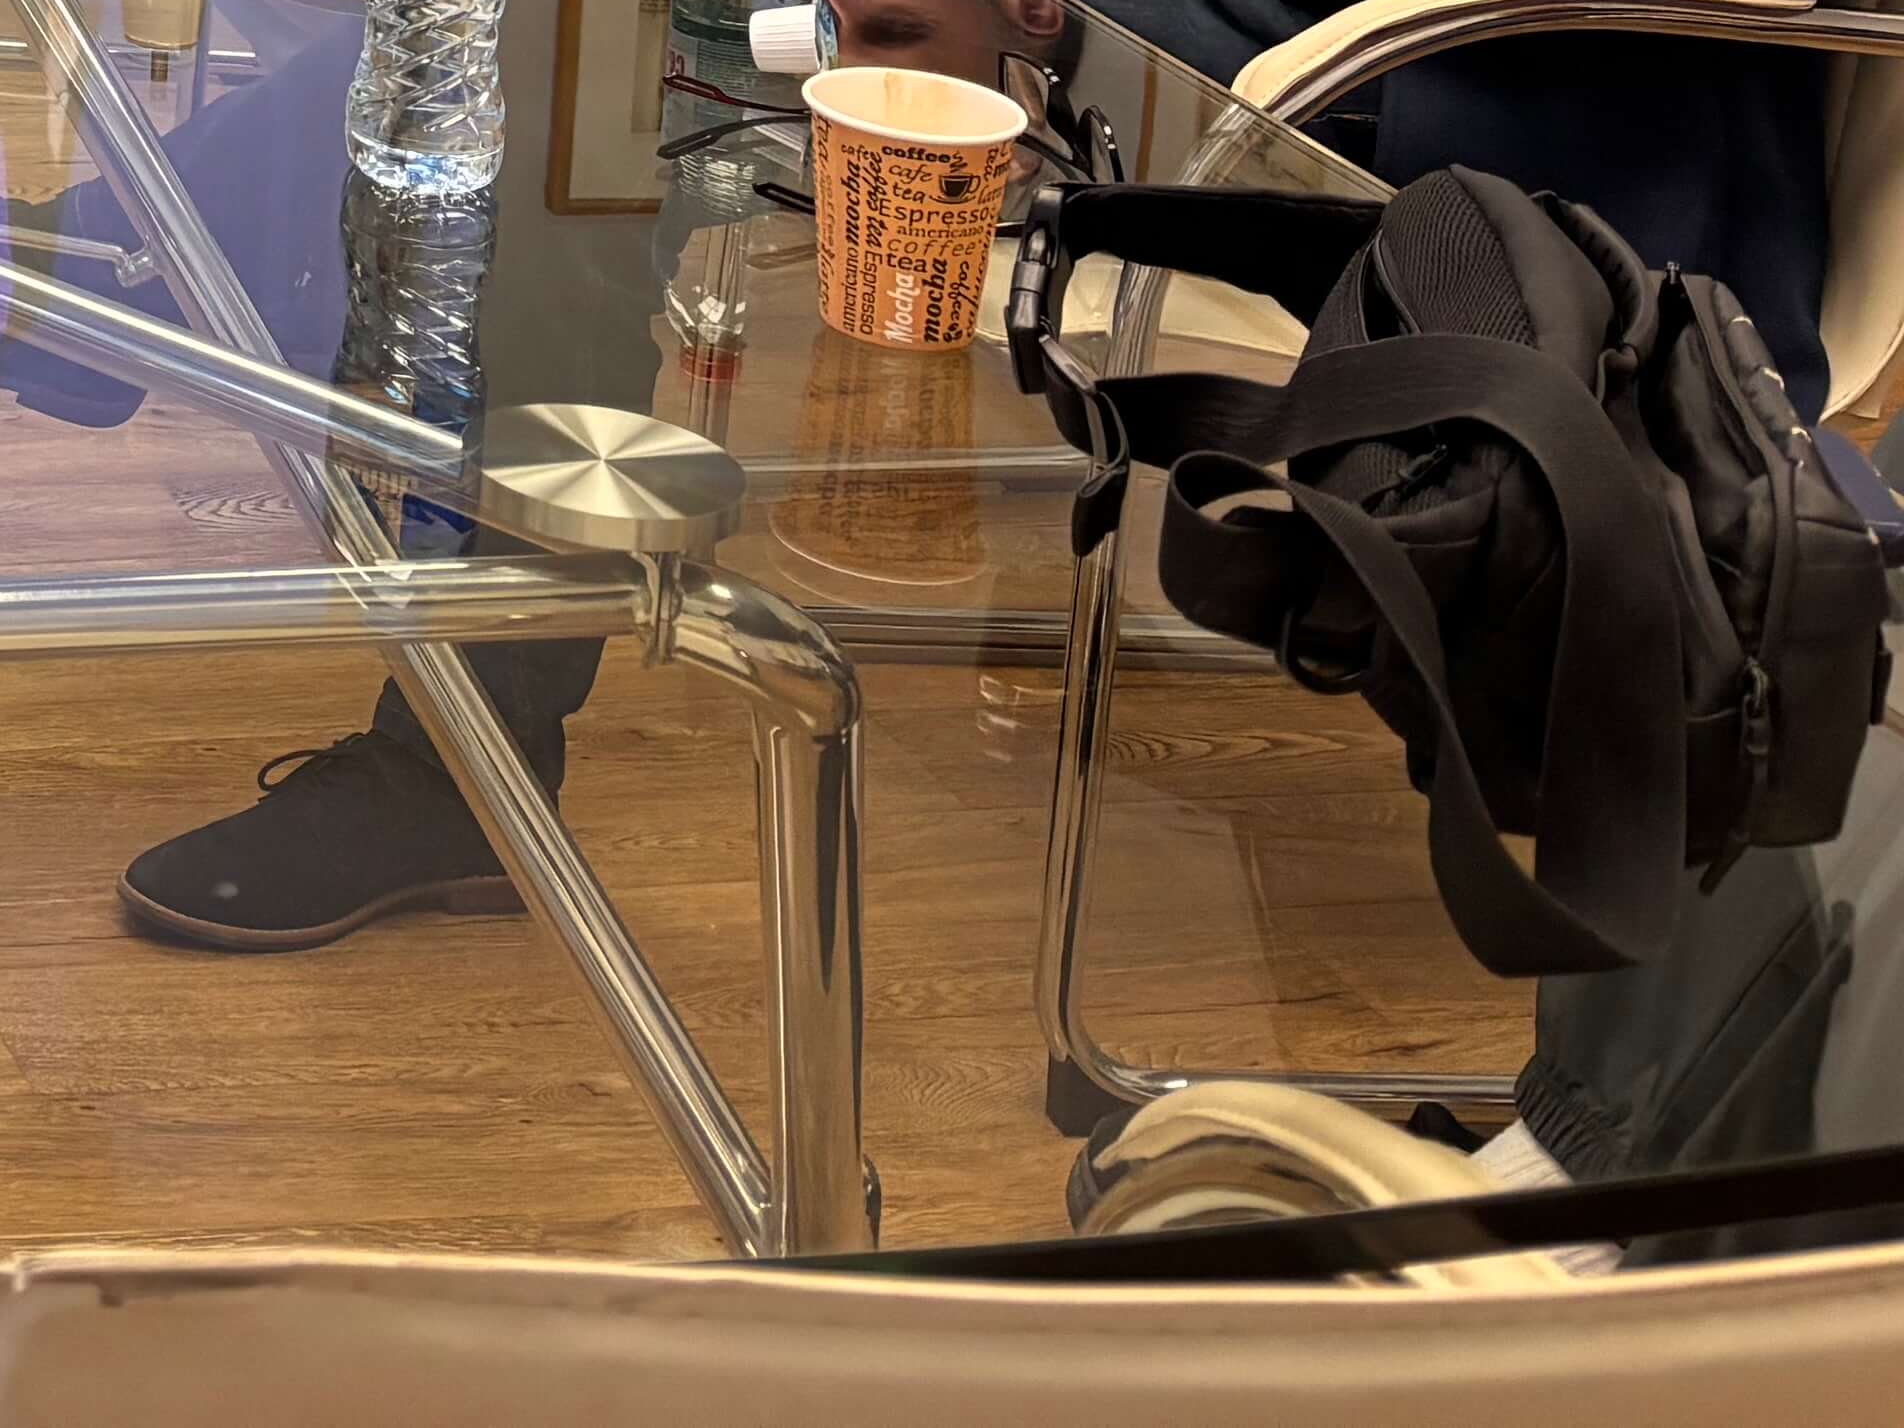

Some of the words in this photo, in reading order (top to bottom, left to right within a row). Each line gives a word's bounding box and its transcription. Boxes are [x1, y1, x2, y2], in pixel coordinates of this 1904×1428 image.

[881, 145, 952, 164] coffee
[889, 163, 933, 184] cafe
[840, 159, 861, 247] mocha
[892, 181, 926, 204] tea
[879, 198, 990, 226] Espresso
[896, 223, 985, 238] americano
[887, 238, 977, 257] coffee
[887, 252, 928, 273] tea
[859, 250, 883, 335] Espresso
[921, 257, 948, 343] mocha
[882, 270, 921, 344] Mocha
